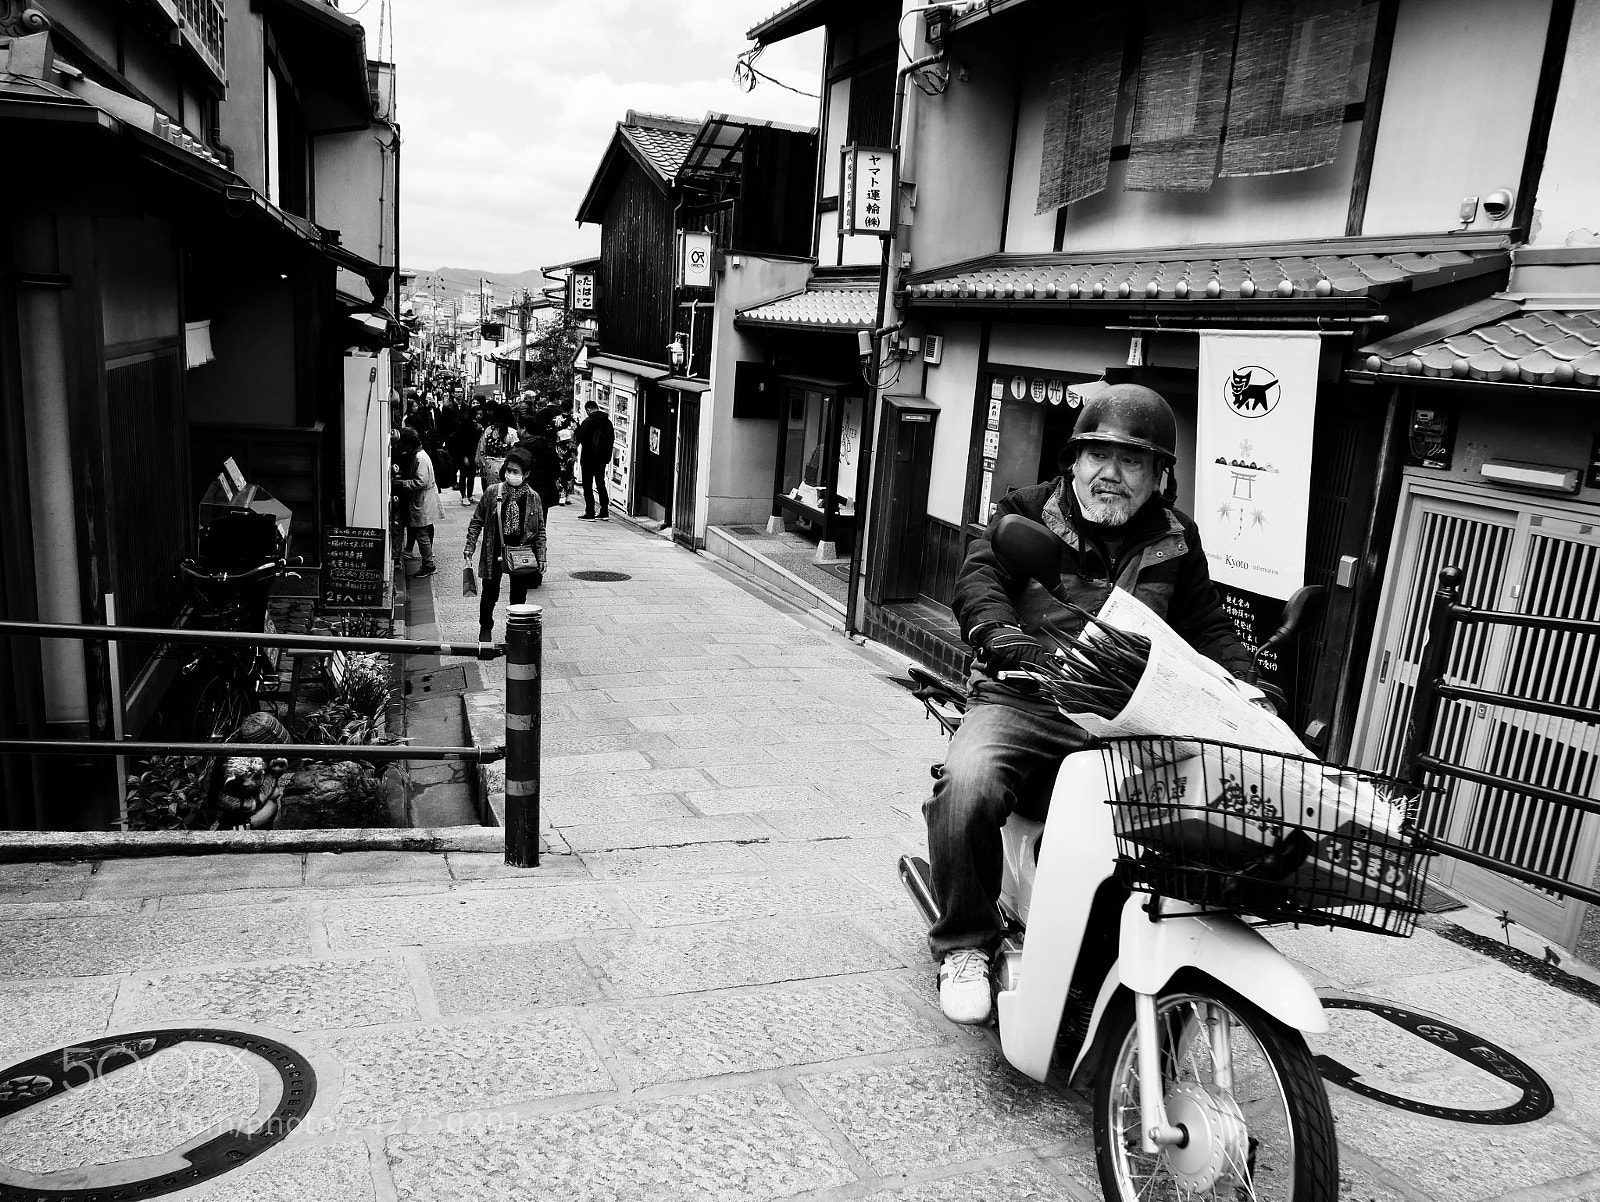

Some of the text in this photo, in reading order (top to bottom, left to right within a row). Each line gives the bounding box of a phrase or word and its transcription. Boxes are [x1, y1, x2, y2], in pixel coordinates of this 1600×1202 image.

[1032, 379, 1089, 407] 観光案
[1225, 554, 1249, 570] Kyoto
